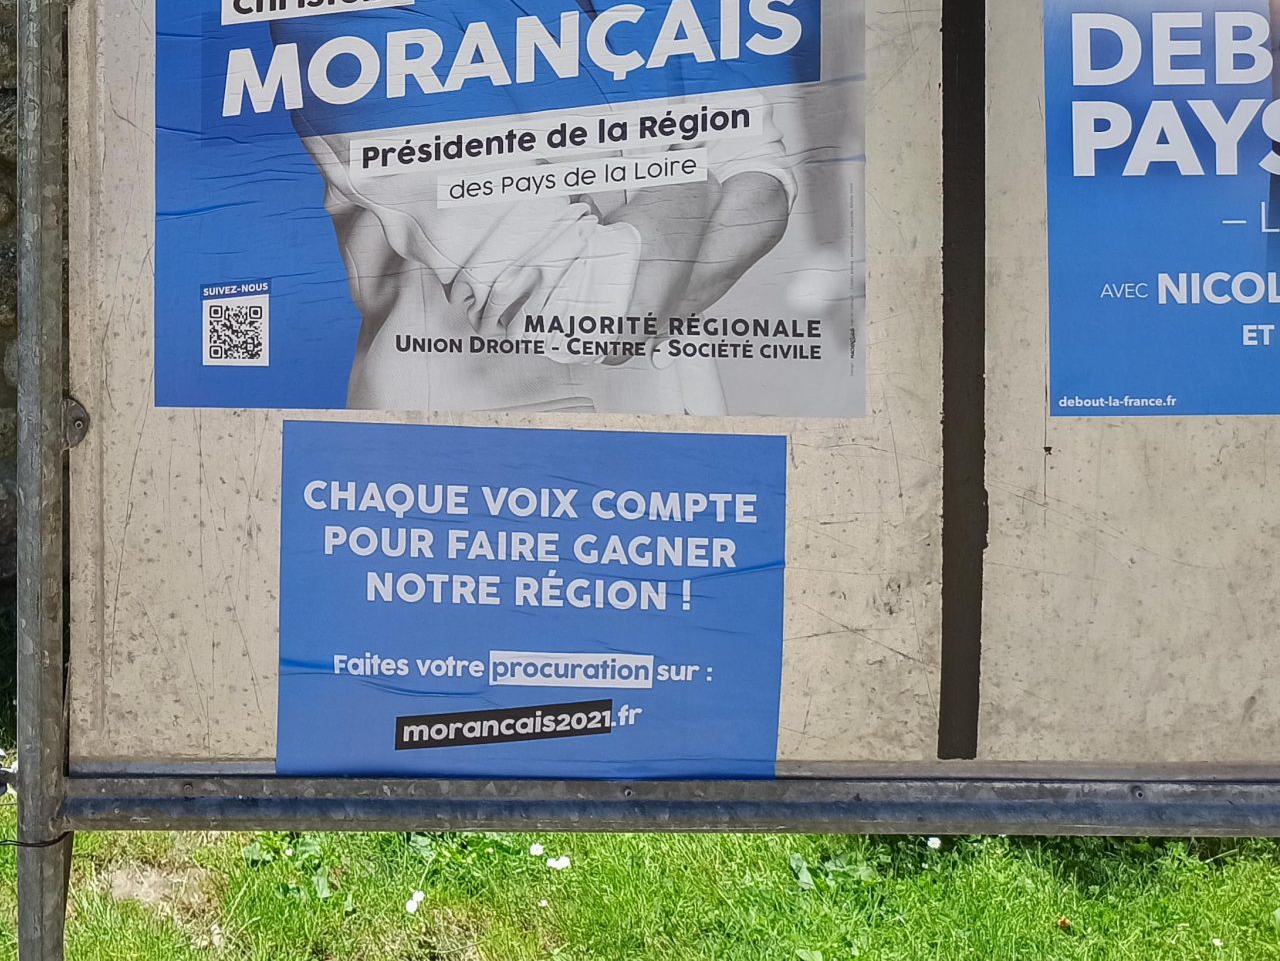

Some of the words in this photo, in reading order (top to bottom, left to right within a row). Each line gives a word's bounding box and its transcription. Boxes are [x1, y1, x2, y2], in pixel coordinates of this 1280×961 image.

[1072, 12, 1274, 86] DEB
[361, 129, 535, 168] Présidente
[547, 122, 586, 148] de
[598, 119, 627, 144] la
[639, 103, 749, 139] Région
[449, 178, 494, 199] des
[501, 171, 557, 200] Pays
[564, 167, 596, 189] de
[604, 163, 626, 184] la
[635, 156, 696, 181] Loire
[203, 283, 268, 296] SUIVEZ-NOUS
[1101, 284, 1148, 298] AVEC
[524, 312, 657, 336] MAJORITÉ
[668, 313, 821, 339] RÉGIONALE
[1243, 325, 1275, 346] ET
[1059, 395, 1176, 407] debout-la-france.fr
[303, 481, 468, 518] CHAQUE
[482, 487, 578, 518] VOIX
[592, 490, 757, 523] COMPTE
[324, 526, 434, 558] POUR
[448, 530, 559, 562] FAIRE
[574, 534, 736, 568] GAGNER
[367, 572, 500, 605] NOTRE
[515, 570, 666, 610] RÉGION
[682, 580, 691, 610] !
[333, 653, 409, 677] Faites
[416, 656, 484, 679] votre
[493, 657, 649, 686] procuration
[657, 665, 699, 682] sur
[402, 705, 641, 743] morancais2021.fr
